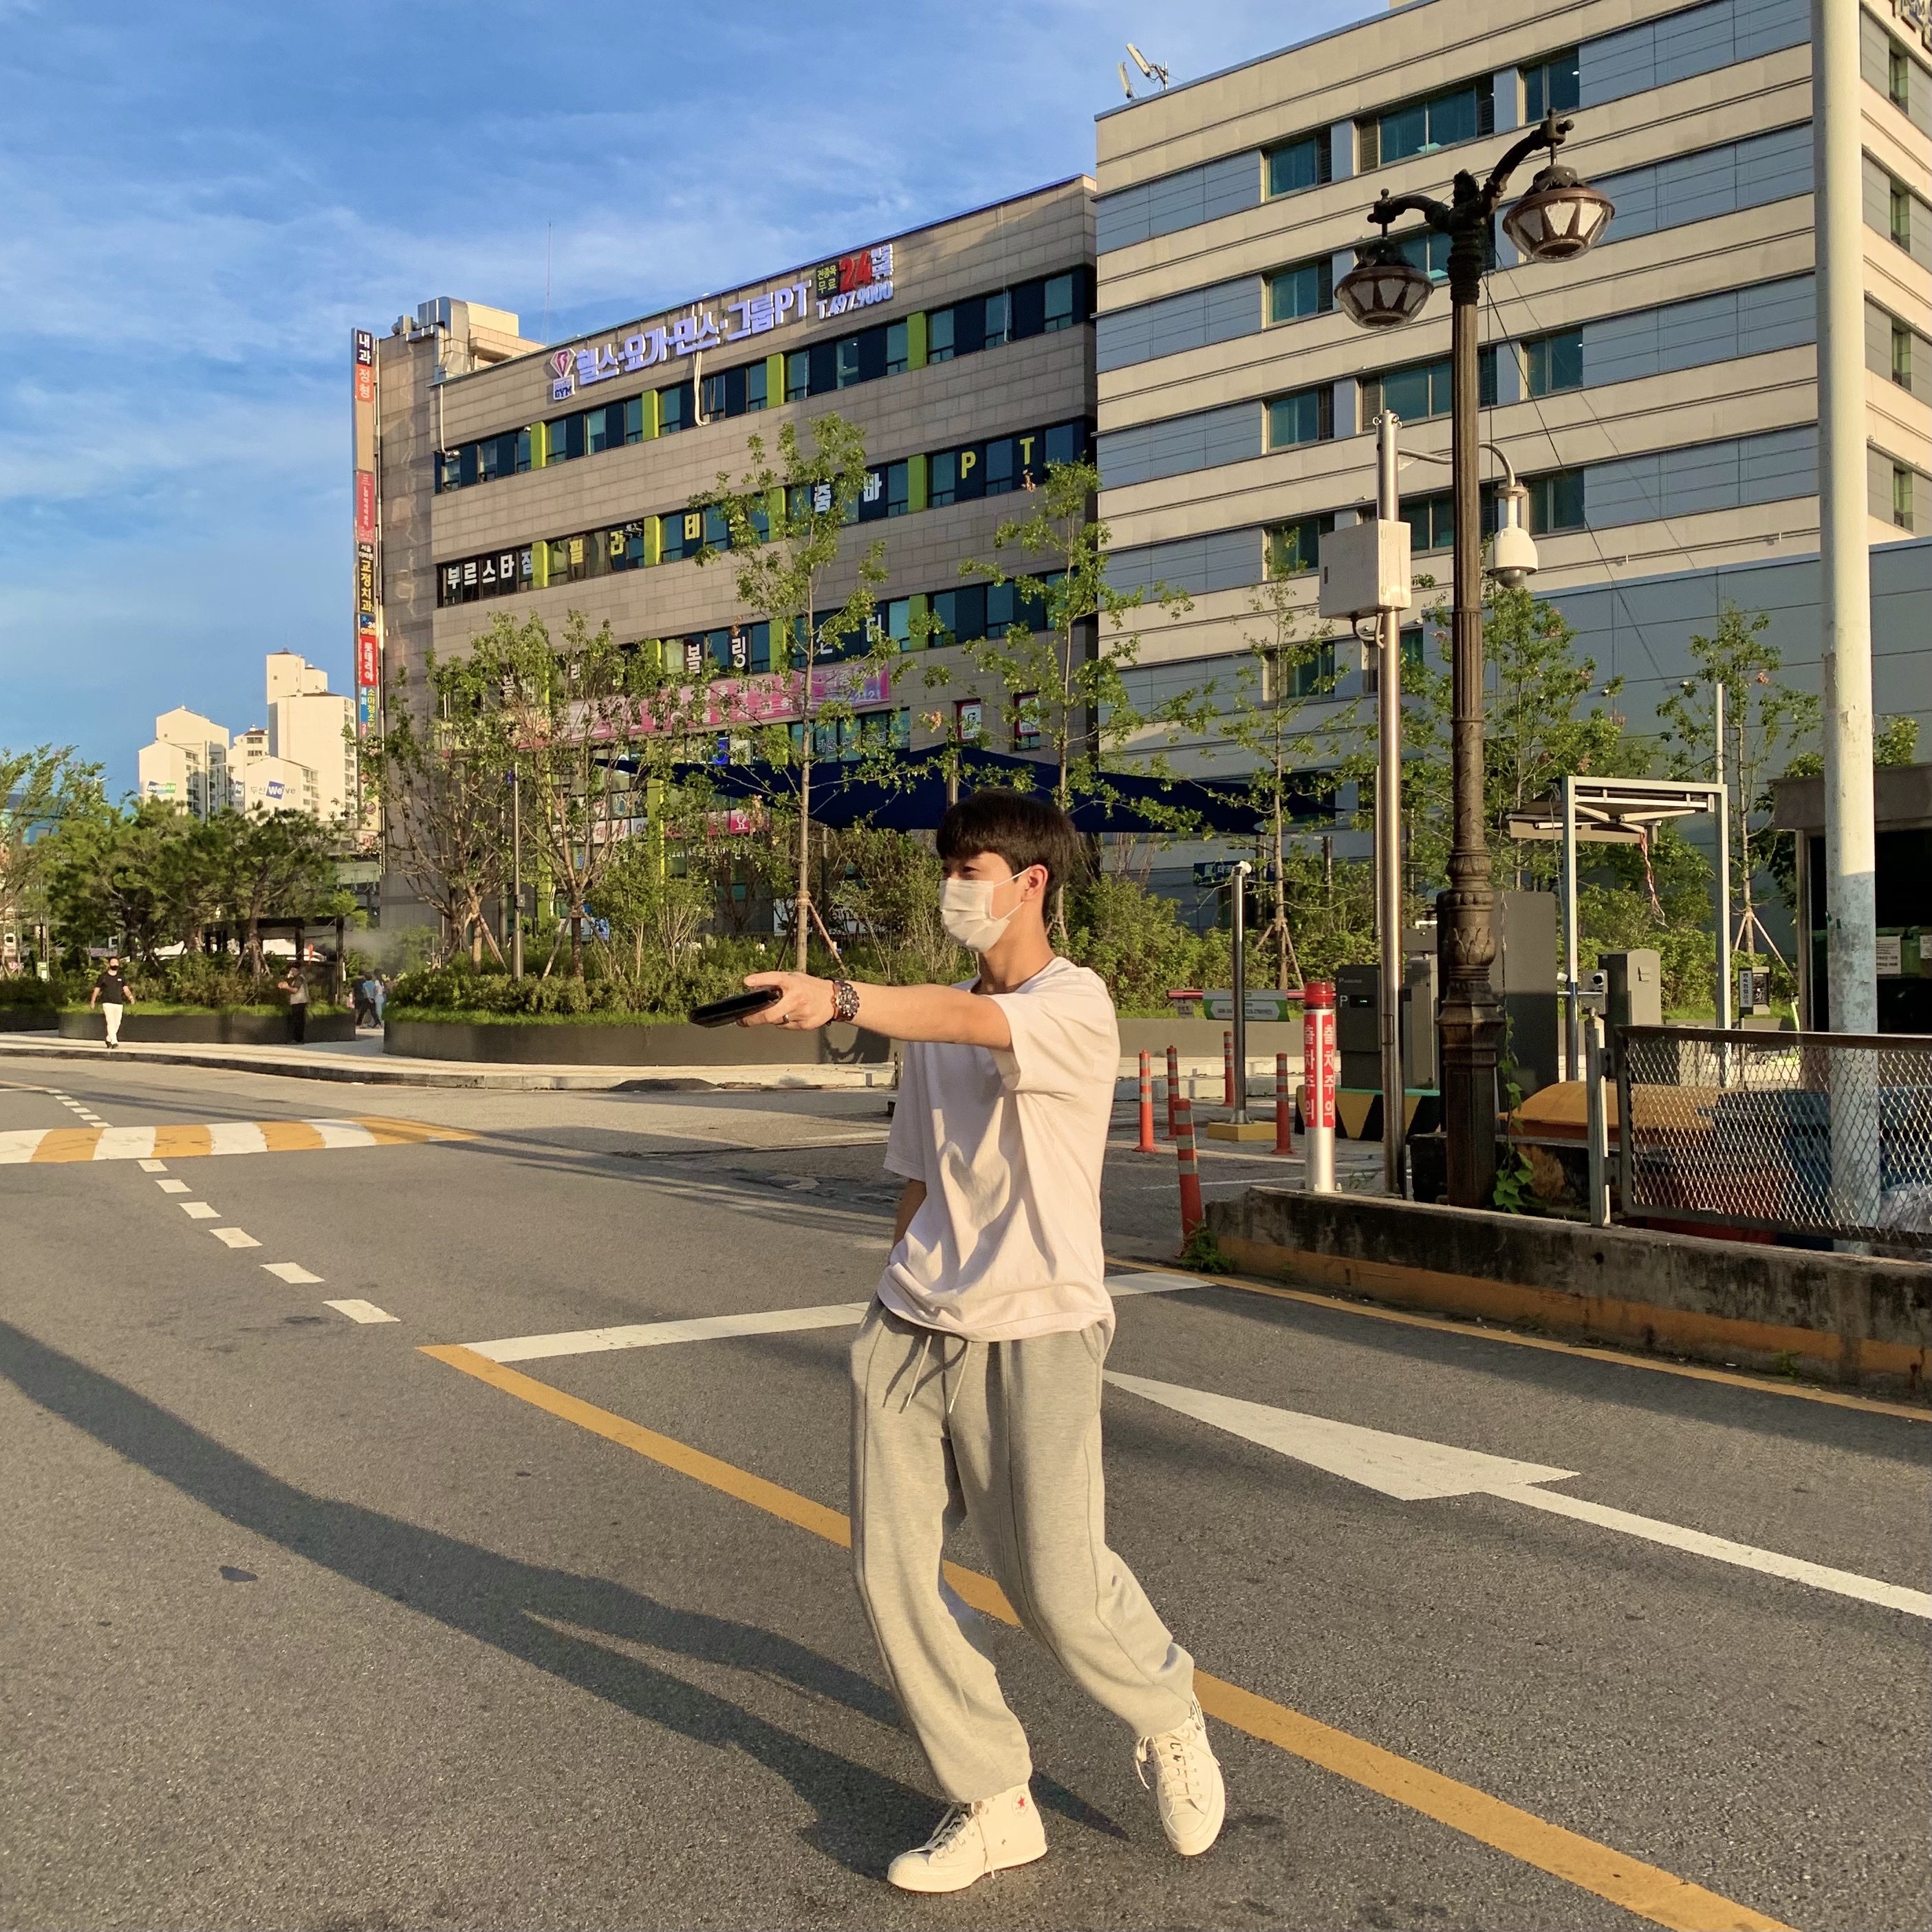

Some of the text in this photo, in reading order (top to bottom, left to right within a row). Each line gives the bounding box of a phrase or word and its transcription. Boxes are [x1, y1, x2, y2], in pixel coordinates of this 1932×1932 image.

[818, 277, 837, 294] 무료
[838, 250, 872, 293] 24
[358, 334, 371, 365] 내과
[555, 385, 572, 398] GYM
[360, 560, 372, 612] 교정치과
[250, 786, 266, 795] 두산
[1304, 1023, 1315, 1120] 출차주의
[1323, 1023, 1334, 1120] 출차주의
